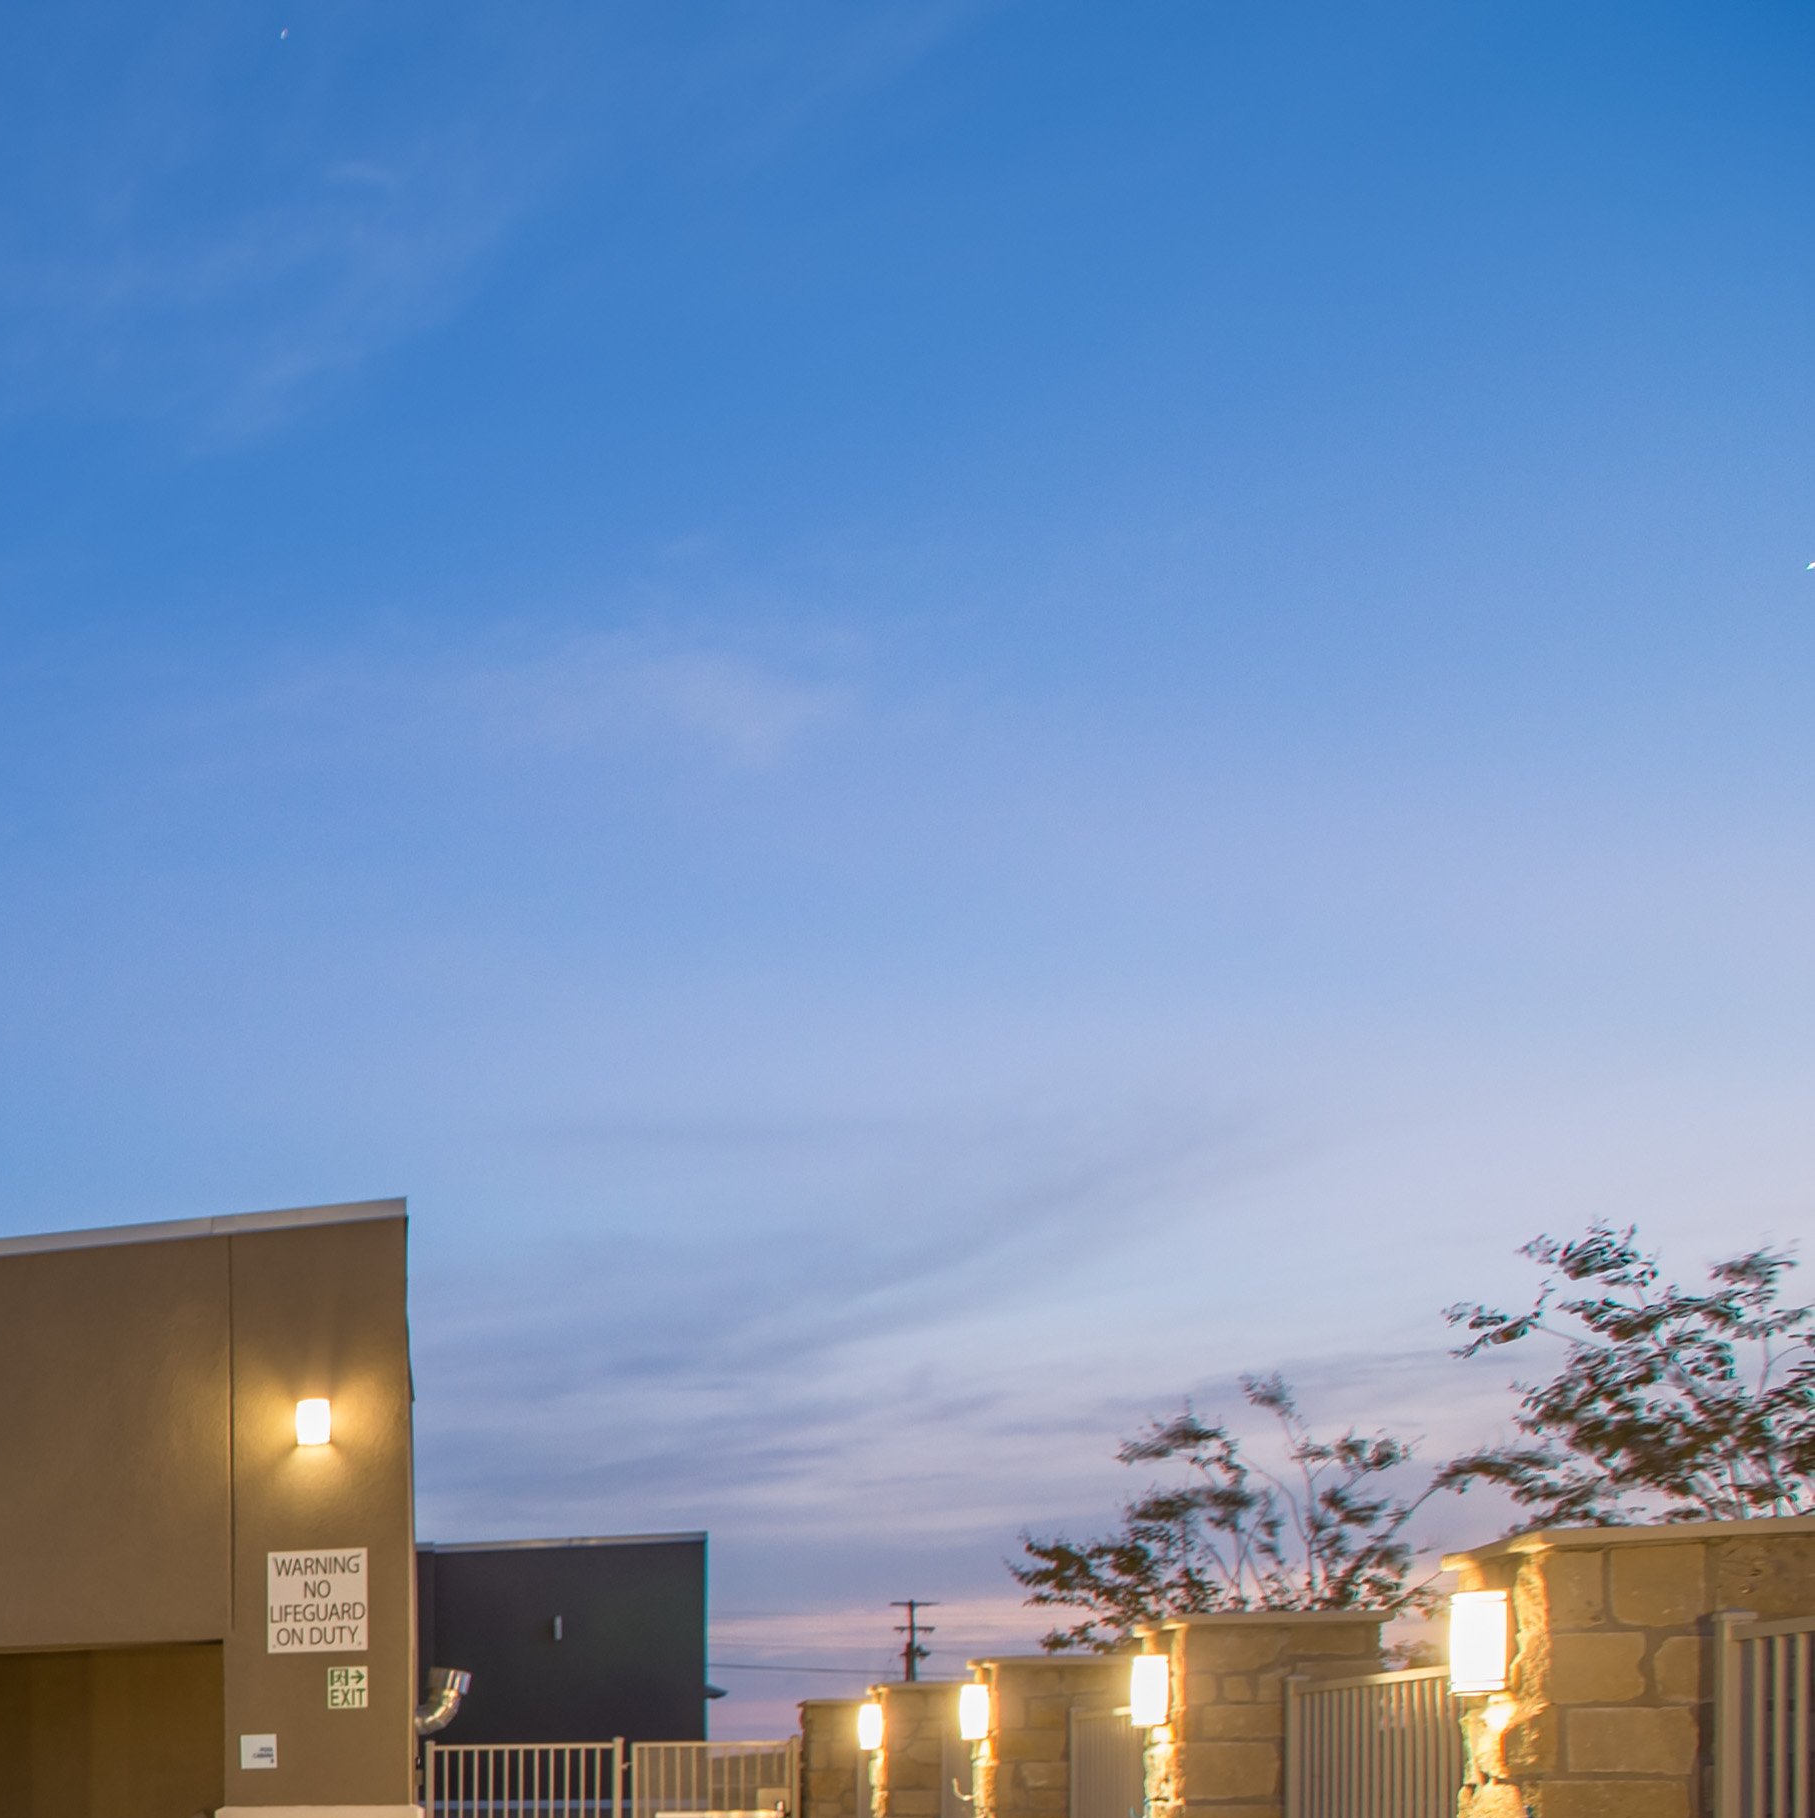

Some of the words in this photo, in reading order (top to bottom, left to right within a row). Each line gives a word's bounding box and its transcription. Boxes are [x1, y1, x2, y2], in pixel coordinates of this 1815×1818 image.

[274, 1554, 360, 1577] WARNING
[304, 1580, 331, 1599] NO
[270, 1602, 365, 1624] LIFEGUARD
[277, 1628, 304, 1647] ON
[310, 1625, 358, 1646] DUTY
[330, 1688, 366, 1707] EXIT
